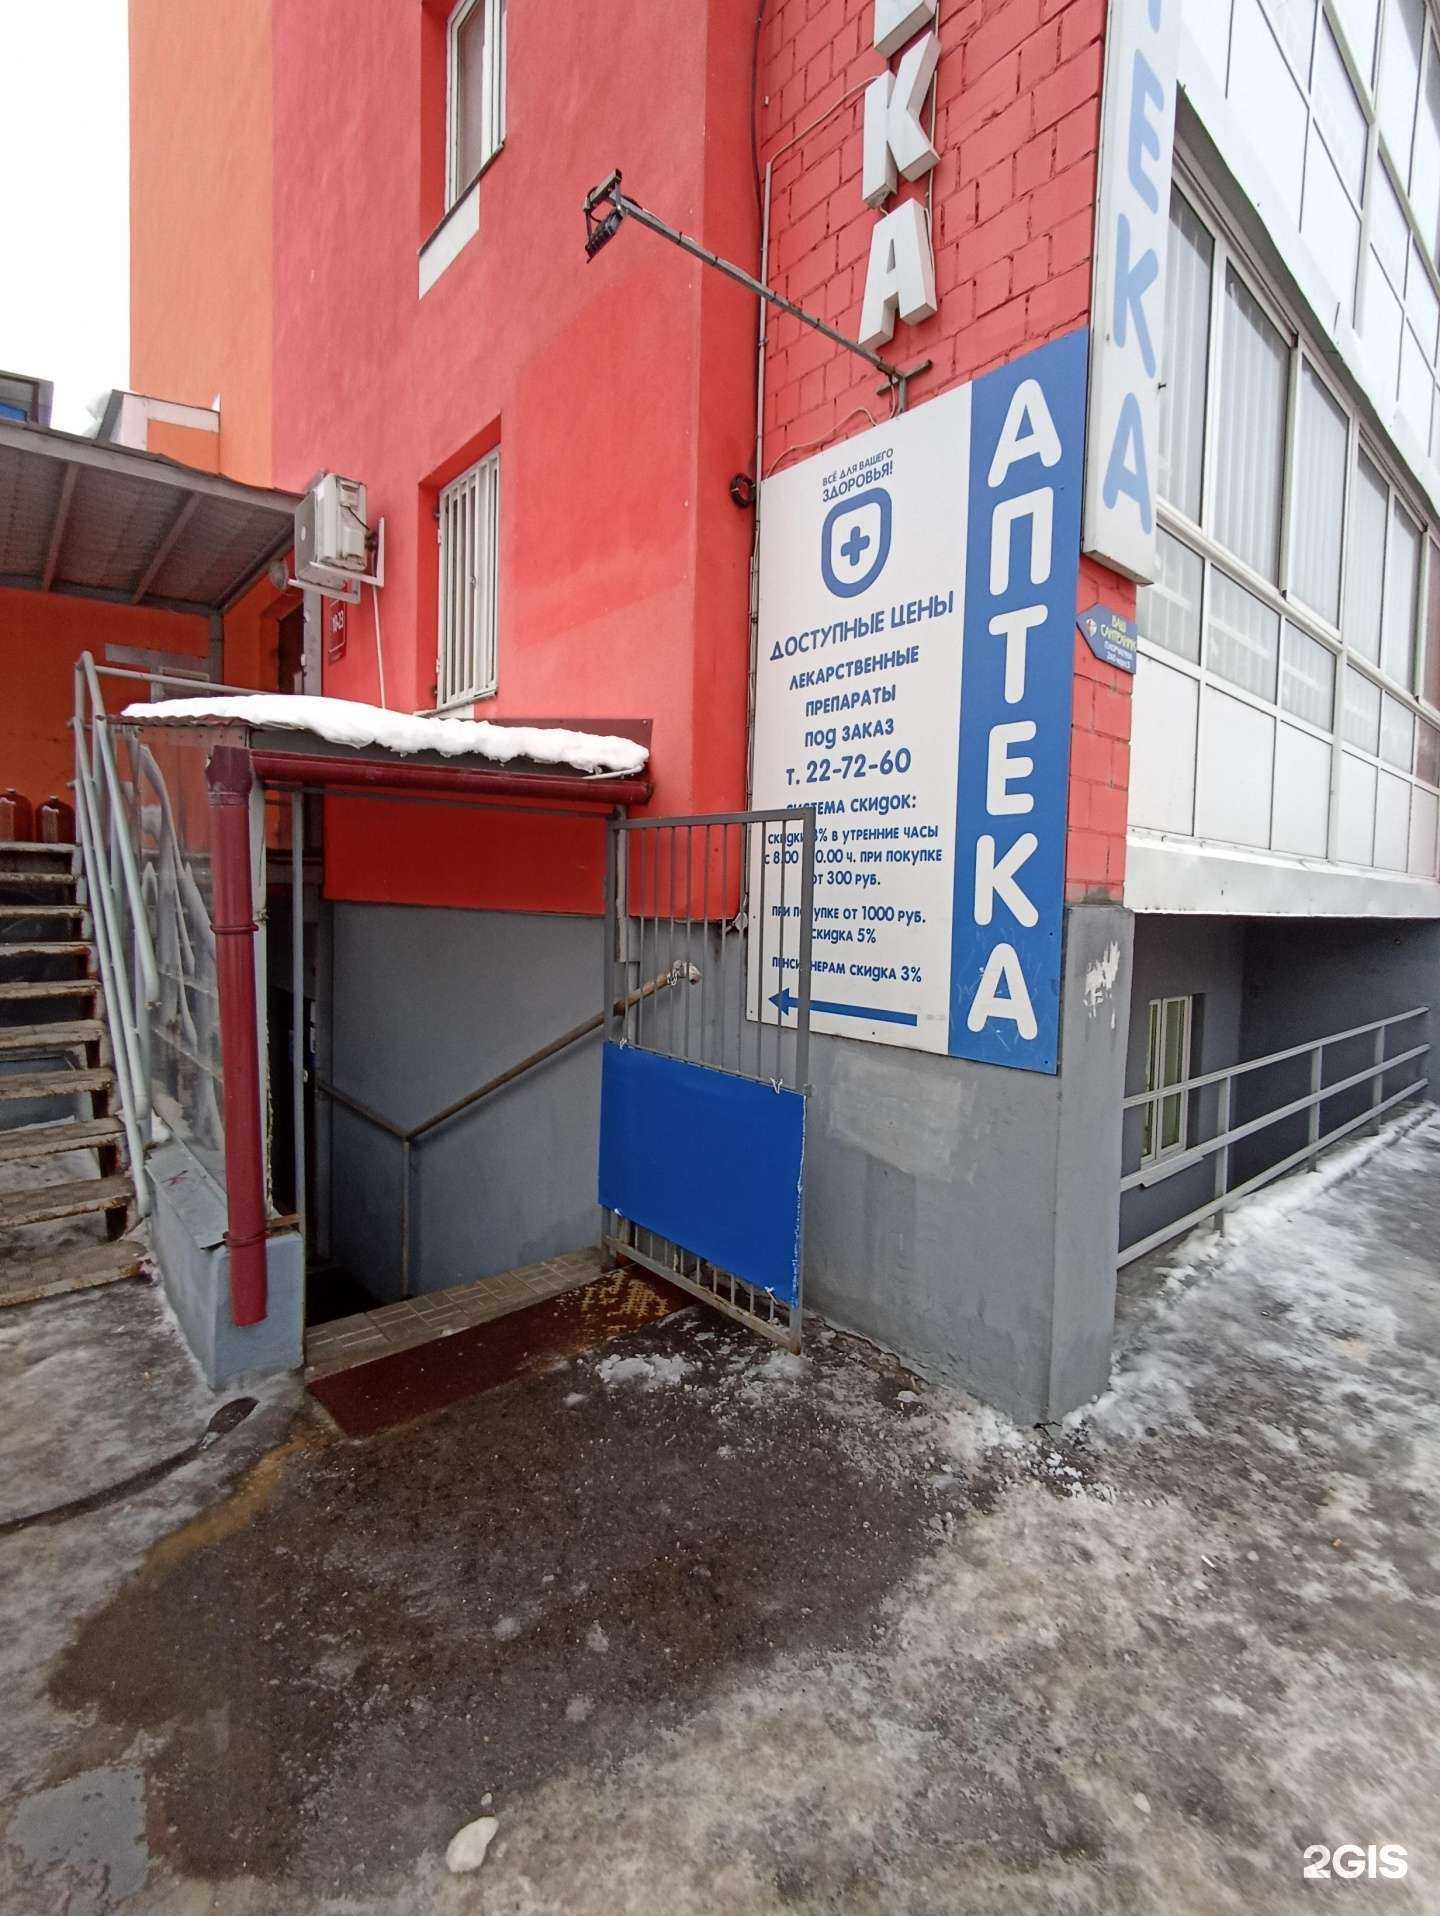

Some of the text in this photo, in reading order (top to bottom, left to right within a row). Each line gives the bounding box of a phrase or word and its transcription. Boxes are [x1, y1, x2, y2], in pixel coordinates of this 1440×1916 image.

[1102, 0, 1165, 535] ЕКА
[839, 464, 858, 480] ДЛЯ
[859, 447, 894, 471] ВАШЕГО
[822, 460, 894, 503] ЗДОРОВЬЯ!
[769, 590, 954, 662] ДОСТУПНЫЕ ЦЕНЫ
[789, 645, 920, 691] ЛЕКАРСТВЕННЫЕ
[805, 684, 897, 718] ПРЕПАРАТЫ
[966, 377, 1062, 1041] АПТЕКА
[841, 717, 895, 742] ЗАКАЗ
[806, 747, 912, 784] 22-72-60
[831, 831, 839, 842] В
[842, 827, 900, 845] УТРЕННИЕ
[903, 825, 939, 839] ЧАСЫ
[814, 848, 843, 865] 0.00
[860, 849, 882, 864] ПРИ
[885, 849, 943, 867] ПОКУПКЕ
[826, 870, 852, 886] 300
[854, 872, 881, 889] РУБ.
[793, 905, 840, 922] ПУПКЕ
[842, 906, 859, 921] ОТ
[862, 905, 895, 923] 1000
[897, 909, 926, 927] РУБ.
[811, 927, 877, 945] СКИДКА 5%
[771, 956, 922, 983] ПНСИНЕРАМ СКИДКА 3%
